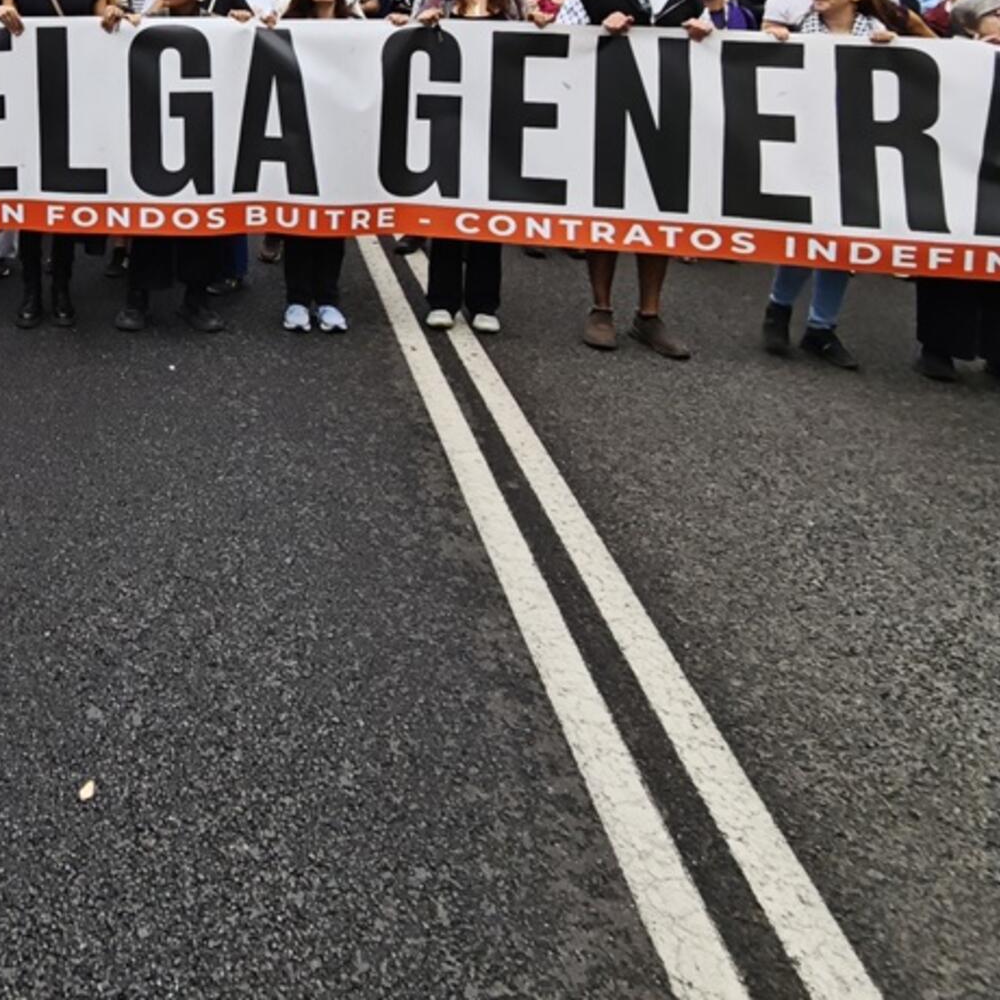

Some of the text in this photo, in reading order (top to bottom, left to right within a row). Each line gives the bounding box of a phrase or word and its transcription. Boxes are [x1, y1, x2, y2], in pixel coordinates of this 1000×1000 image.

[47, 205, 226, 230] FONDOS
[246, 205, 396, 230] BUITRE
[455, 212, 756, 254] CONTRATOS
